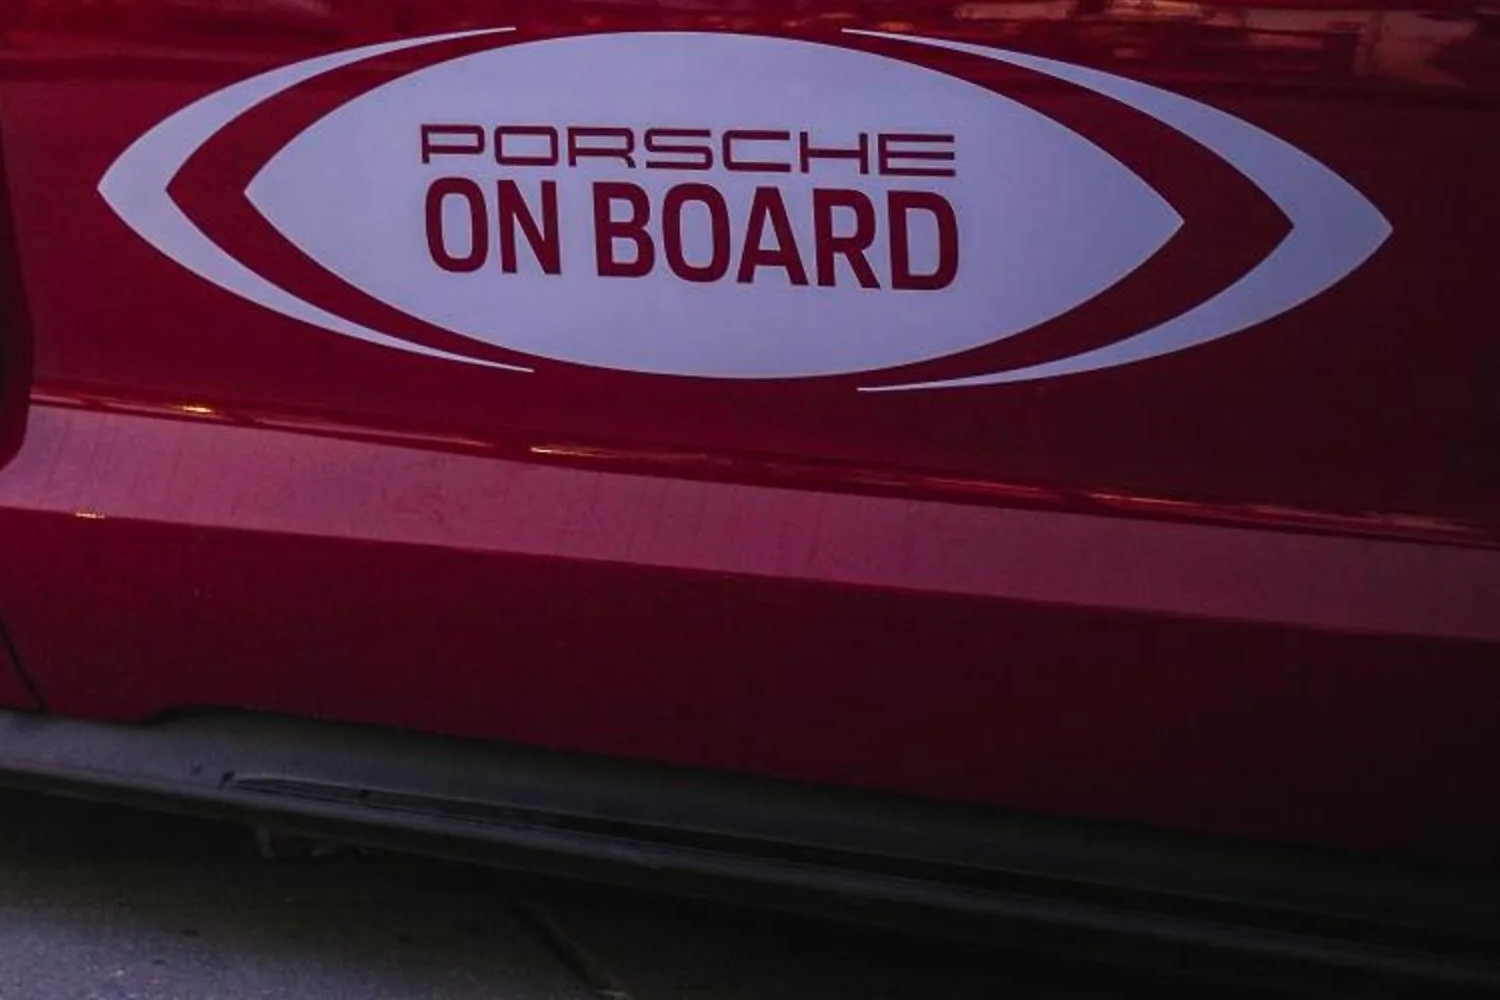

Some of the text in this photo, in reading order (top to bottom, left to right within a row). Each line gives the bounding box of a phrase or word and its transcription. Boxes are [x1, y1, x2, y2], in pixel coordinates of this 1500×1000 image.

[420, 124, 956, 178] PORSCHE
[425, 176, 959, 291] ON BOARD
